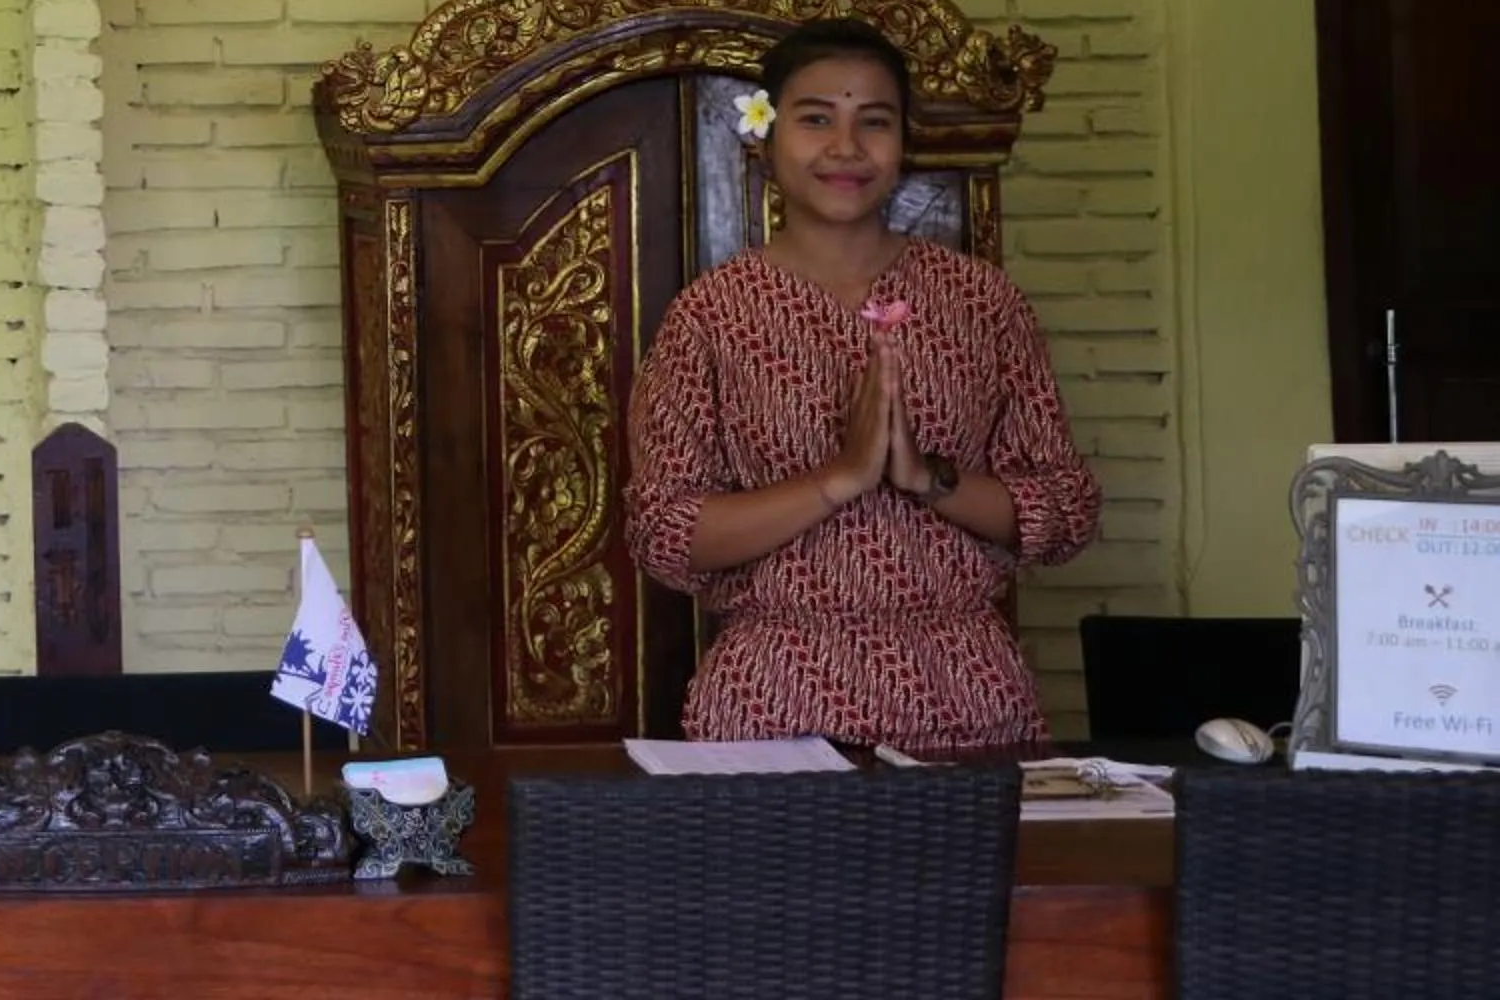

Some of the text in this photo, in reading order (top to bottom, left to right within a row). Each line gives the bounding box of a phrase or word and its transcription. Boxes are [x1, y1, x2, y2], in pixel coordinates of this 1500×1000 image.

[1419, 517, 1439, 532] IN
[1345, 525, 1409, 544] CHECK
[1393, 711, 1493, 737] Free Wi-Fi
